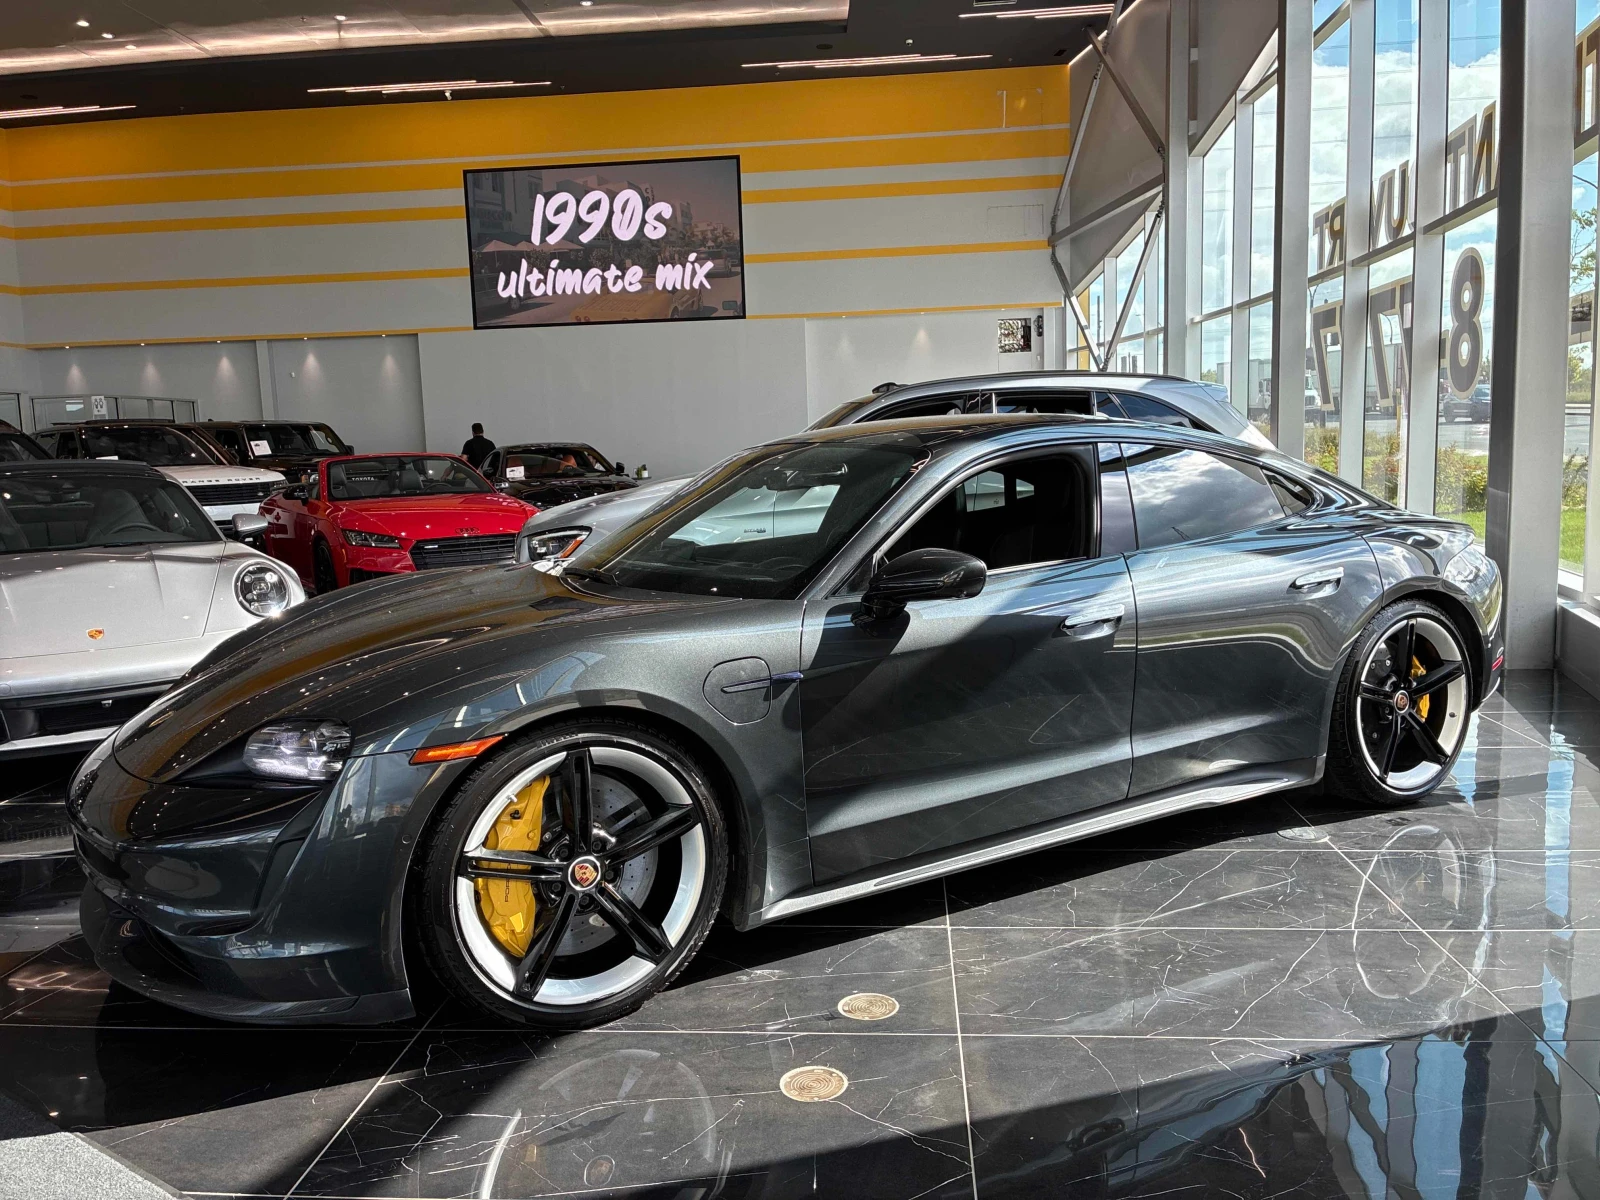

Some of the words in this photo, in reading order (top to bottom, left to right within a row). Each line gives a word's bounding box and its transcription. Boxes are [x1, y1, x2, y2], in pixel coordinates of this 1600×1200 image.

[531, 189, 673, 246] 1990s
[497, 258, 643, 298] ultimate
[655, 252, 714, 291] mix
